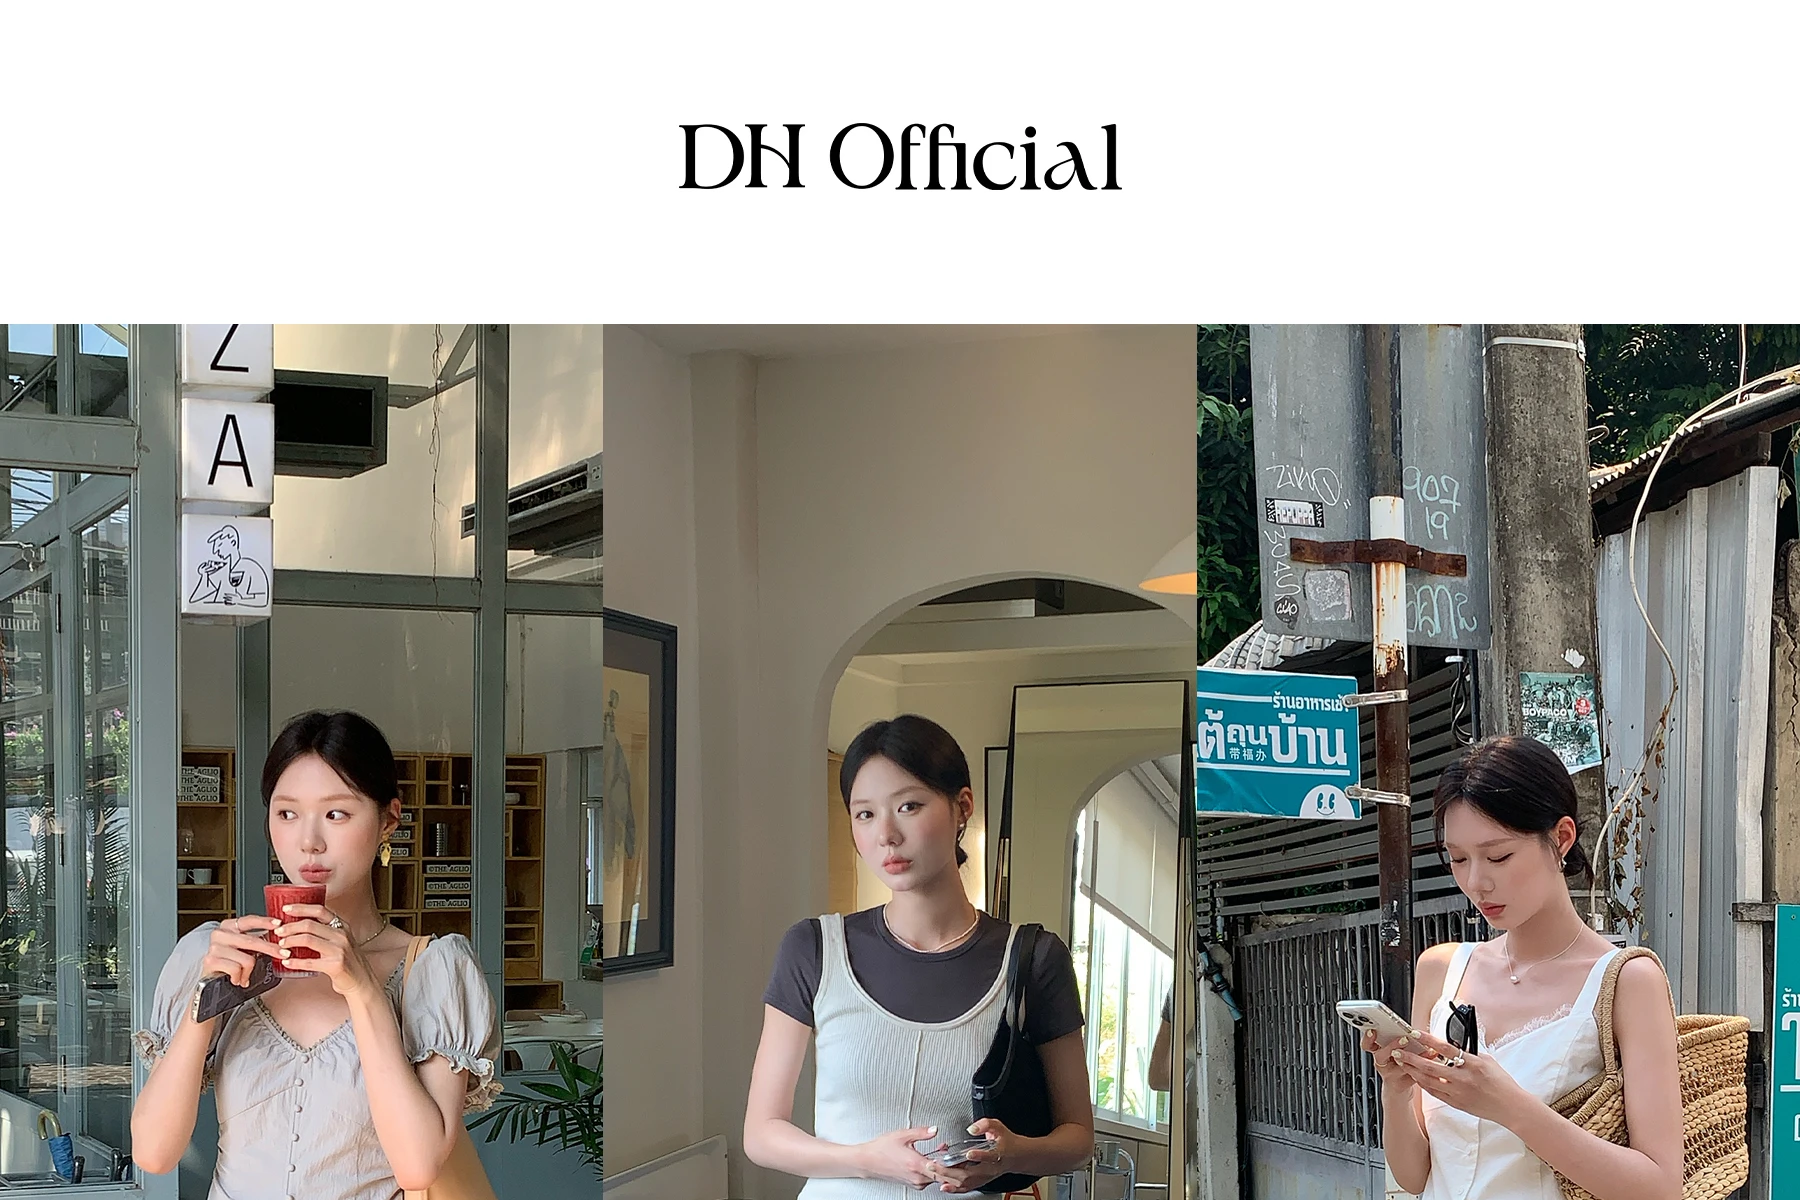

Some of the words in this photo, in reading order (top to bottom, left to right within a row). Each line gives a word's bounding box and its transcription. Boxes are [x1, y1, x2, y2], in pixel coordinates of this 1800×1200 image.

[1272, 691, 1350, 713] ร้านอาหารเช้
[449, 865, 470, 873] AGLIO
[448, 882, 470, 890] AGLIO
